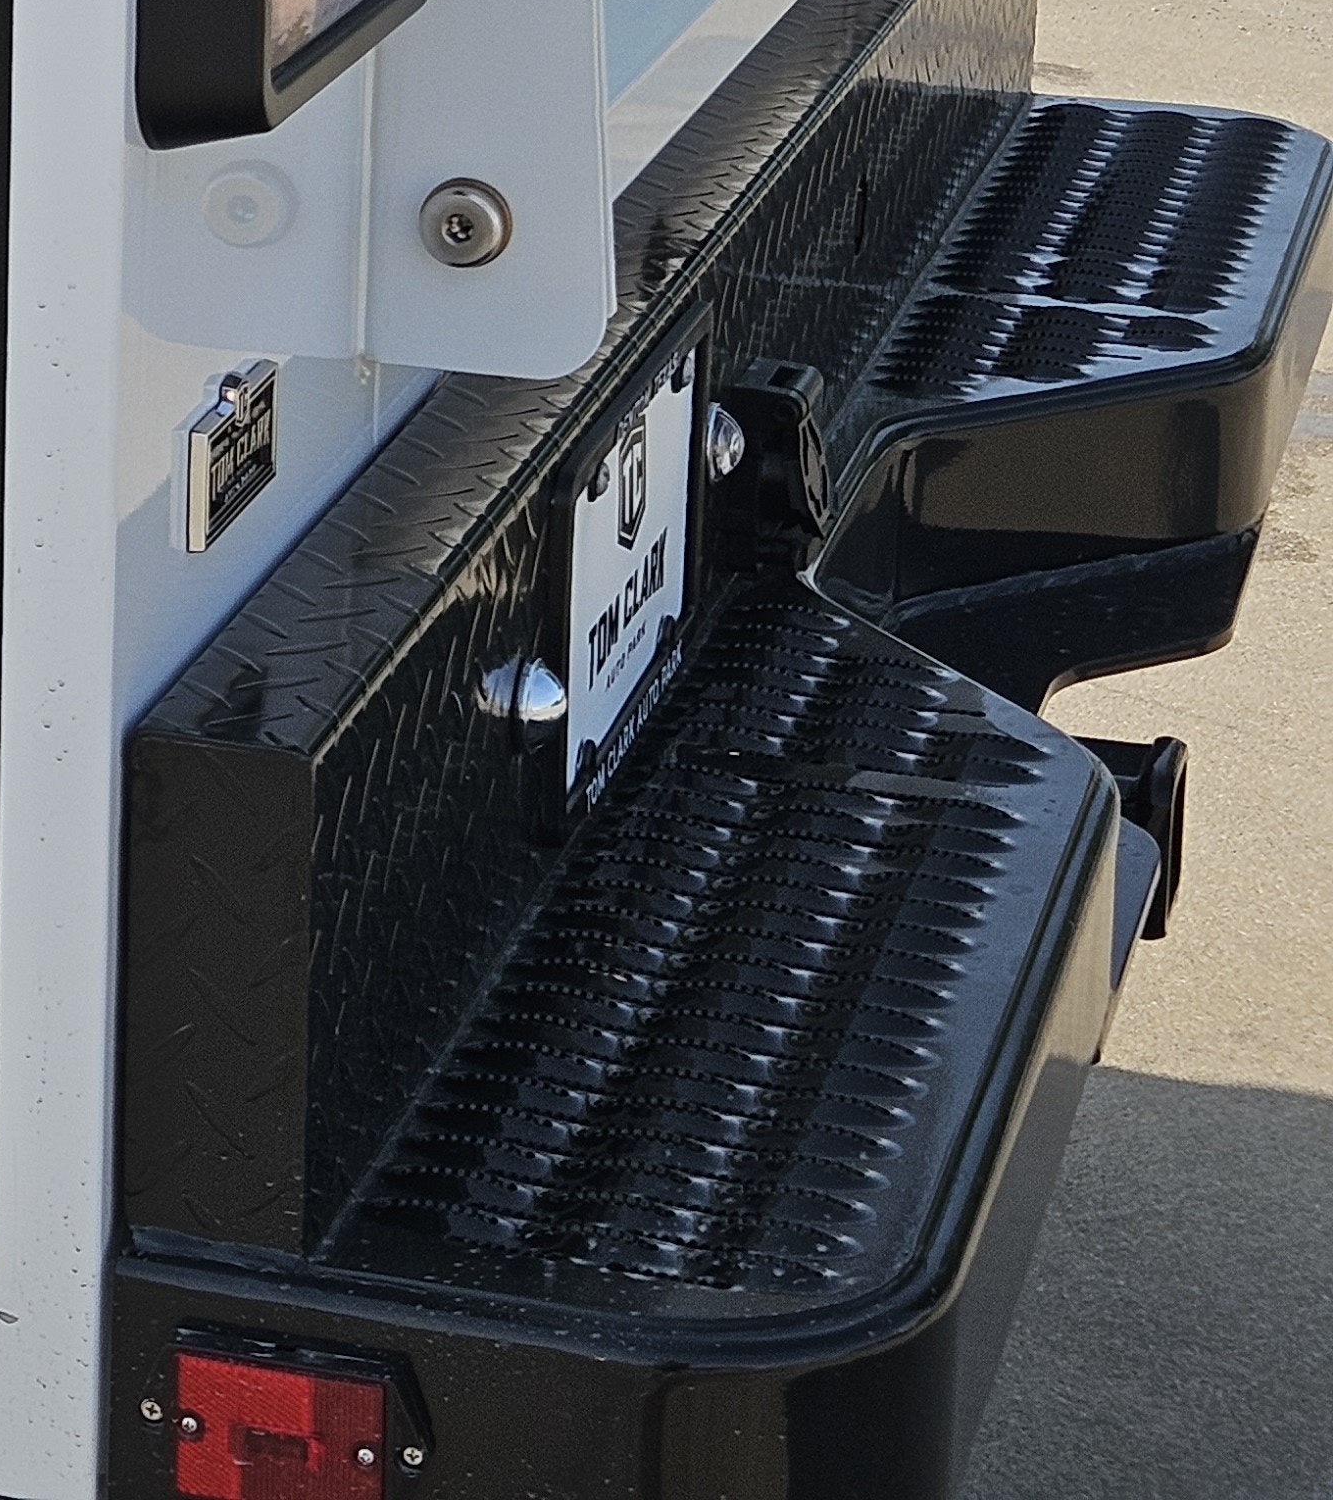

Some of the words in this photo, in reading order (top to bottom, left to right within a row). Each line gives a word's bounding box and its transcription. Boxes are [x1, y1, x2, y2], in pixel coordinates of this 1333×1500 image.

[211, 447, 235, 501] TOM
[236, 408, 271, 466] CLARK
[588, 593, 620, 692] TOM
[623, 526, 667, 630] CLARK
[586, 762, 606, 814] TOM
[607, 714, 635, 779] CLARK
[636, 677, 660, 734] AUTO
[661, 638, 683, 693] PARK
